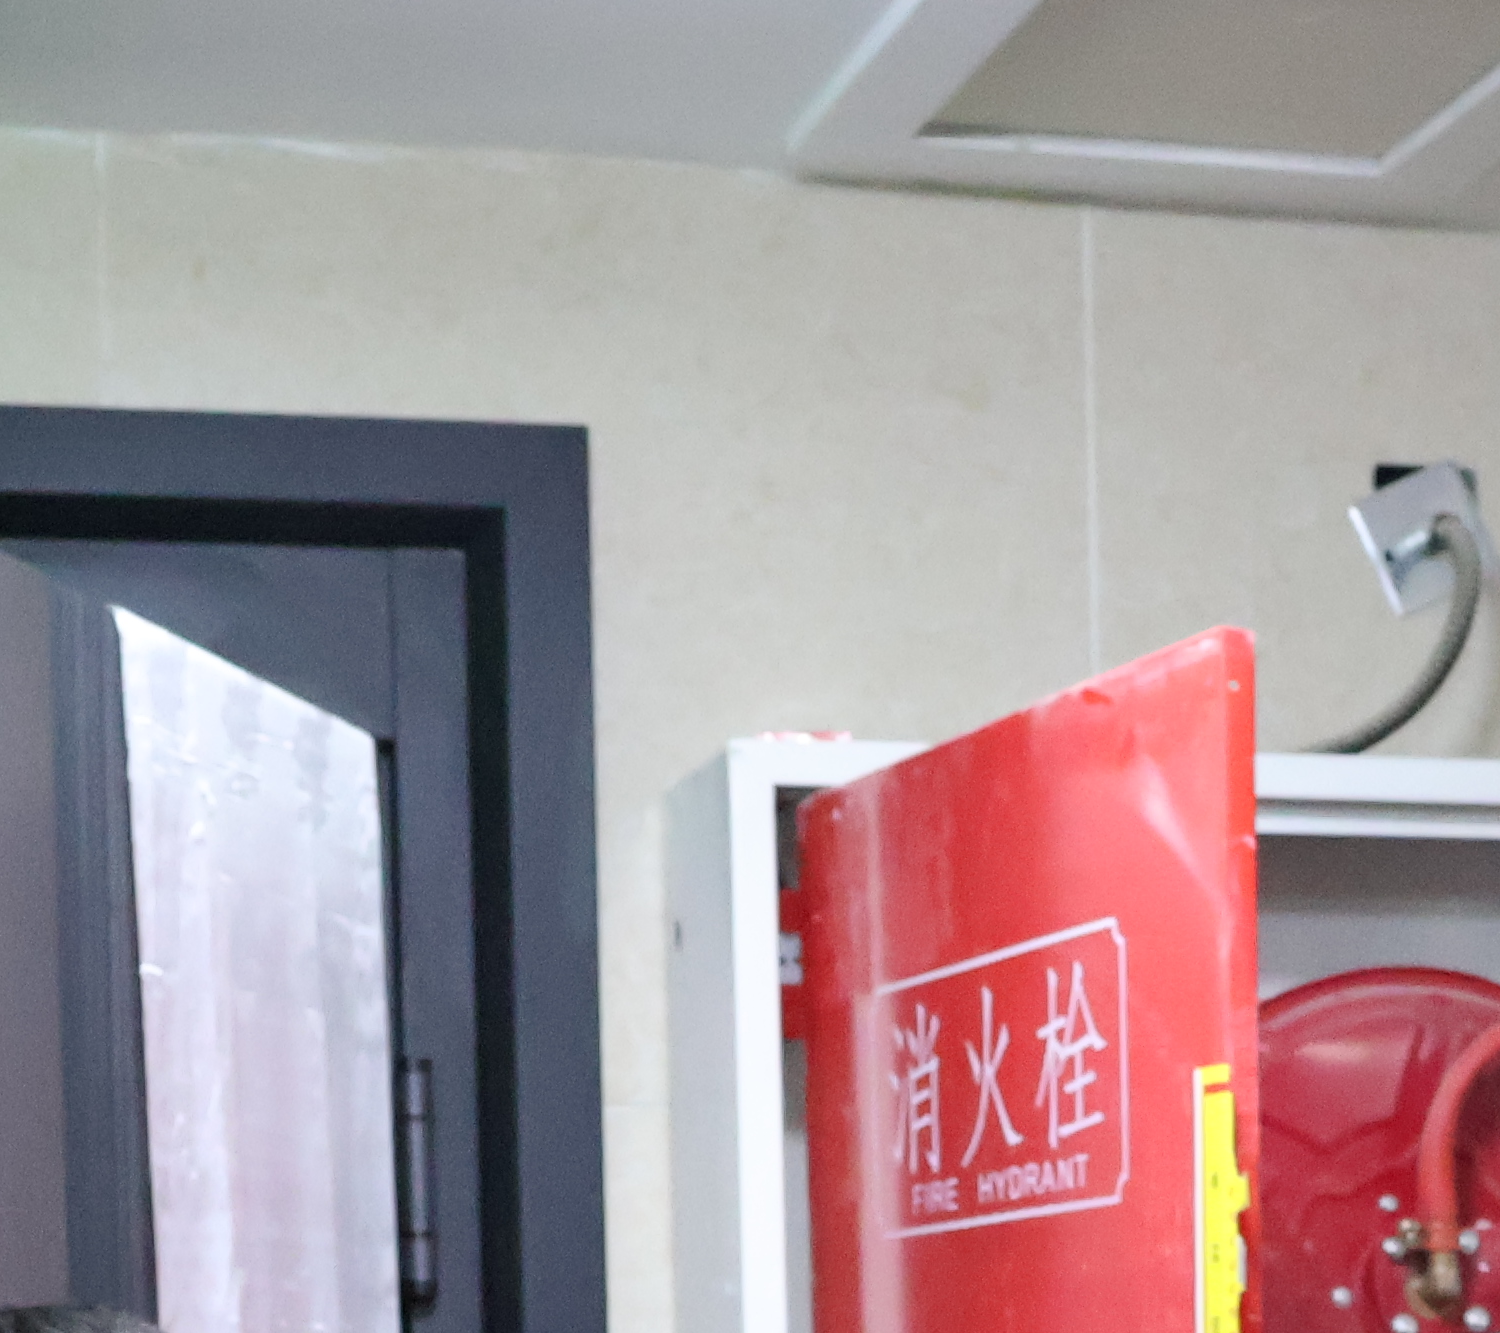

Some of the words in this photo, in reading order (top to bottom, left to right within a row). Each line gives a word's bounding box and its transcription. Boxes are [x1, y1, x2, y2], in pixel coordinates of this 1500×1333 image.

[888, 960, 1108, 1174] 消火栓
[911, 1178, 959, 1213] FIRE
[977, 1154, 1089, 1202] HYDRANT
